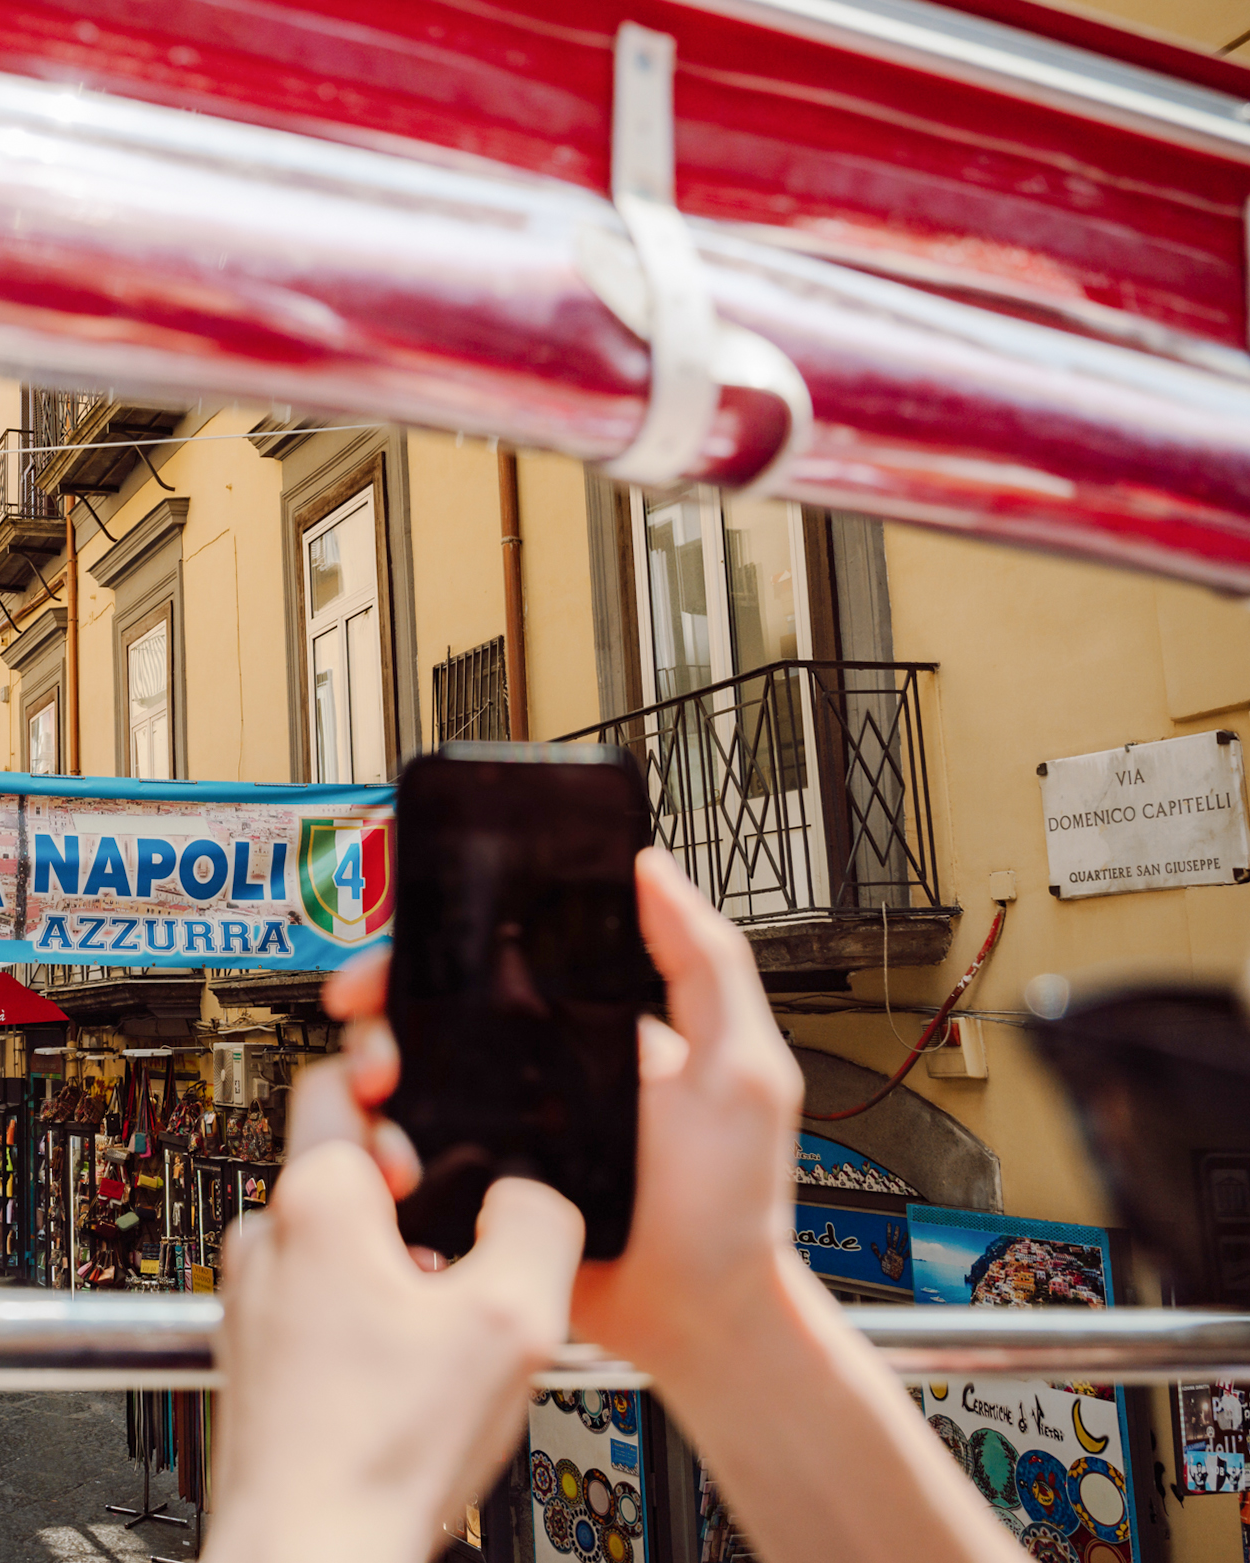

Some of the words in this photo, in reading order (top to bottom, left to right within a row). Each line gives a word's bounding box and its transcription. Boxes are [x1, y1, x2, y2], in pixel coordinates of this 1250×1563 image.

[1115, 768, 1145, 786] VIA
[1048, 806, 1136, 832] DOMENICO
[1142, 792, 1232, 819] CAPITELLI
[34, 833, 288, 901] NAPOLI
[331, 842, 366, 901] 4
[1069, 866, 1133, 884] QUARTIERE
[1136, 863, 1161, 877] SAN
[1165, 858, 1221, 874] GIUSEPPE
[36, 914, 293, 955] AZZURRA
